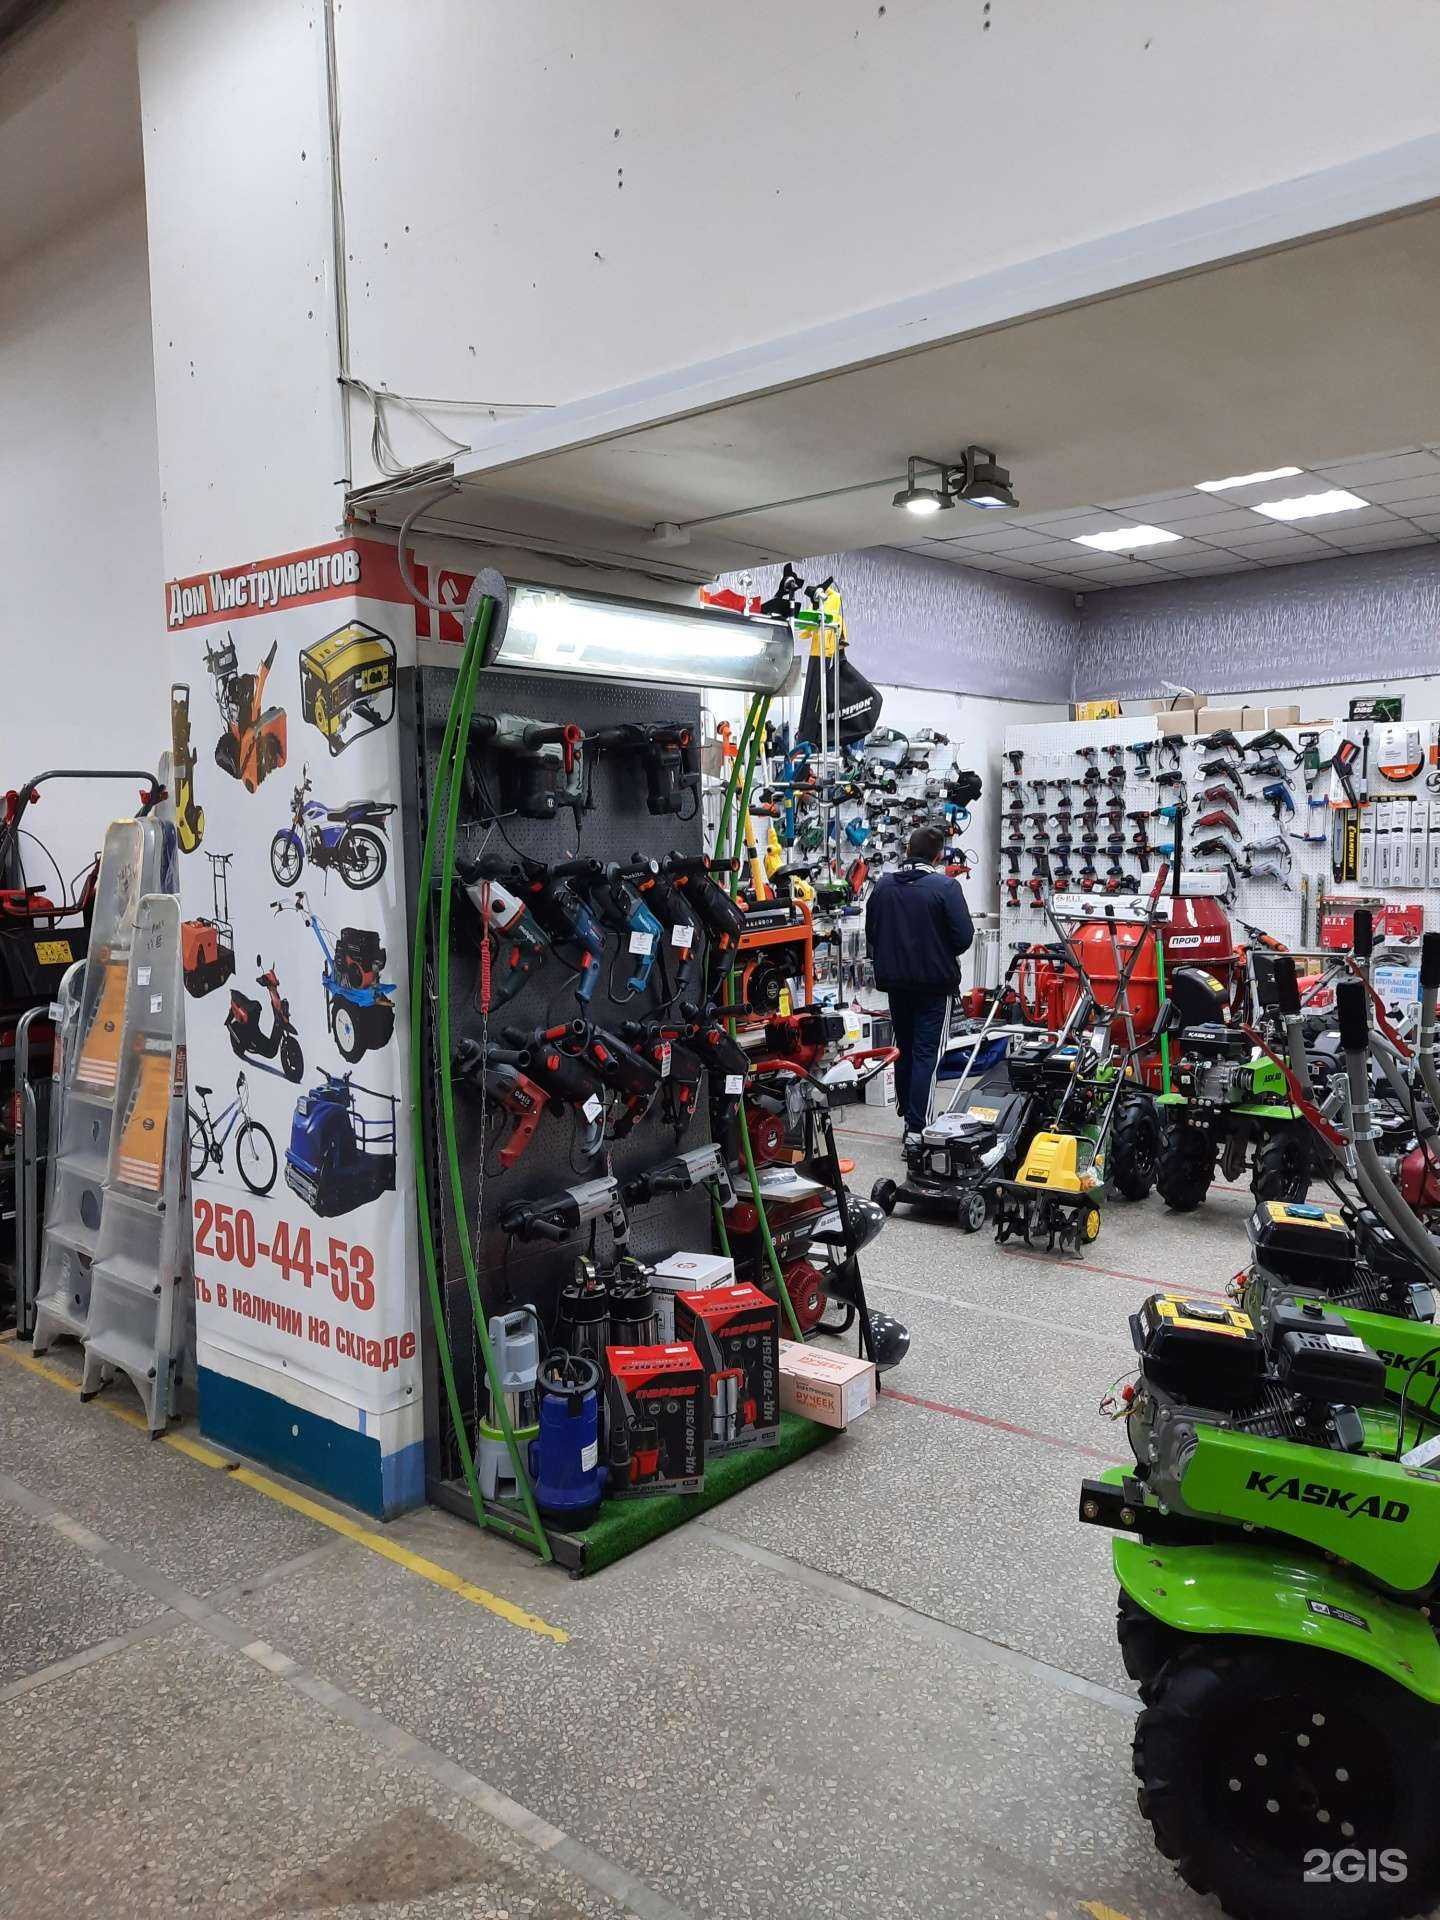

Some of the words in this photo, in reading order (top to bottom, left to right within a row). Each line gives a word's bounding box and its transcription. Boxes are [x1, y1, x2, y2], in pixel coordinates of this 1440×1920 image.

[169, 583, 208, 627] Дом
[208, 549, 361, 609] Инструментов
[820, 696, 873, 723] HAMPION
[1171, 935, 1200, 947] ПРОФ
[1323, 917, 1348, 927] P.I.T.
[193, 1198, 376, 1312] 250-44-53
[193, 1276, 212, 1304] ть
[217, 1283, 228, 1308] в
[233, 1288, 303, 1338] наличии
[308, 1315, 331, 1348] на
[335, 1326, 417, 1373] складе
[1245, 1470, 1410, 1524] KASKAD
